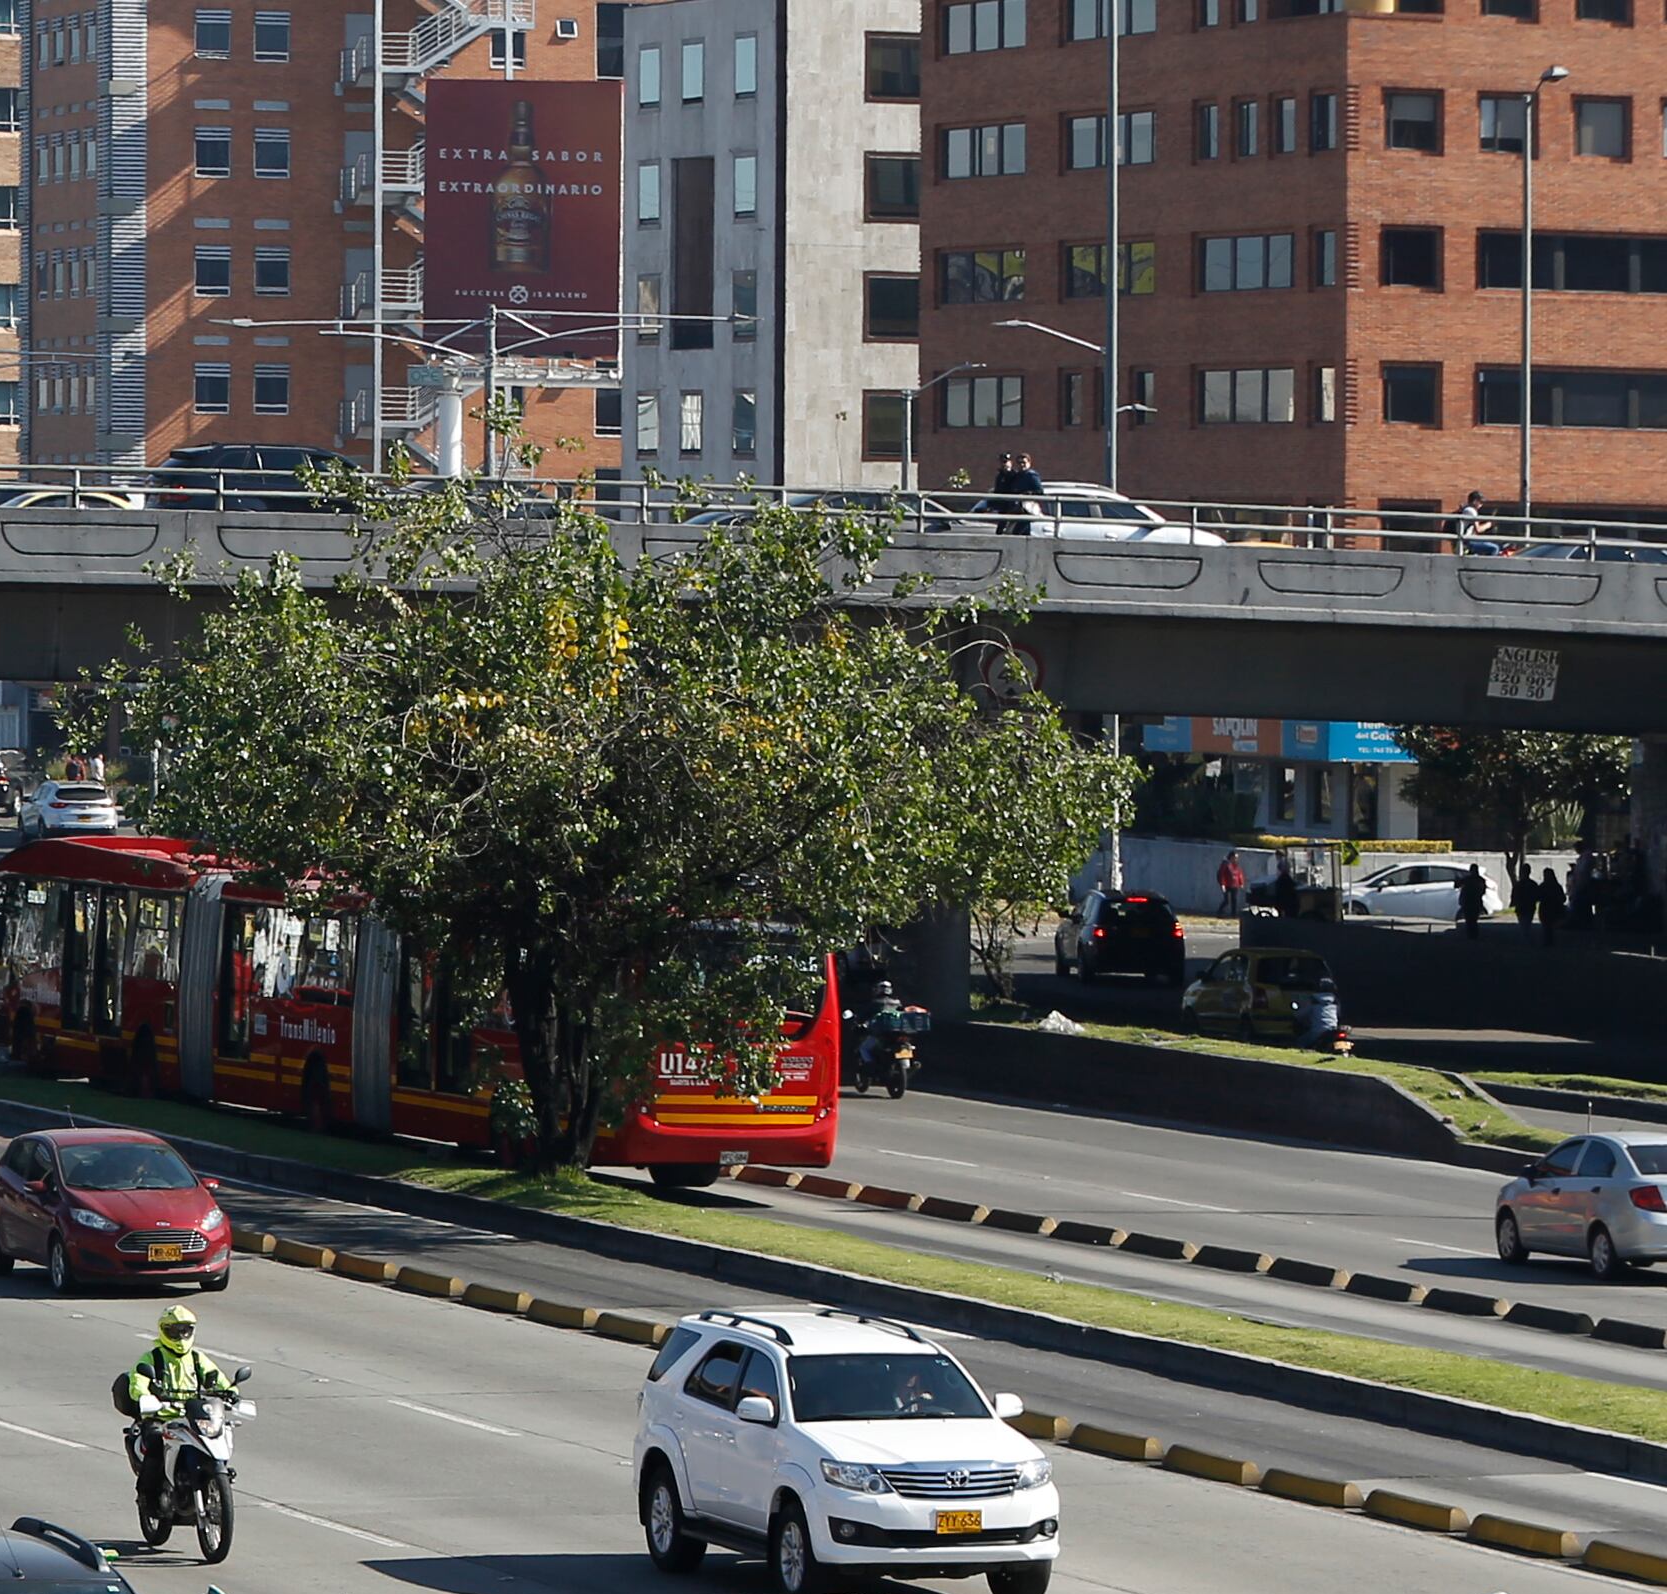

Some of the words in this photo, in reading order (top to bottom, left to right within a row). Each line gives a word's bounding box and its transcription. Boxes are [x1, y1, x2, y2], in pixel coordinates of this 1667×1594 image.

[438, 148, 508, 160] EXTRA
[531, 150, 603, 162] SABOR
[438, 181, 603, 195] EXTRAORDINARIO
[455, 289, 505, 297] SUCCESS
[1495, 647, 1560, 665] ENGLISH
[1527, 676, 1555, 688] 907
[1527, 686, 1544, 699] 50
[280, 1015, 335, 1044] TransMilenio
